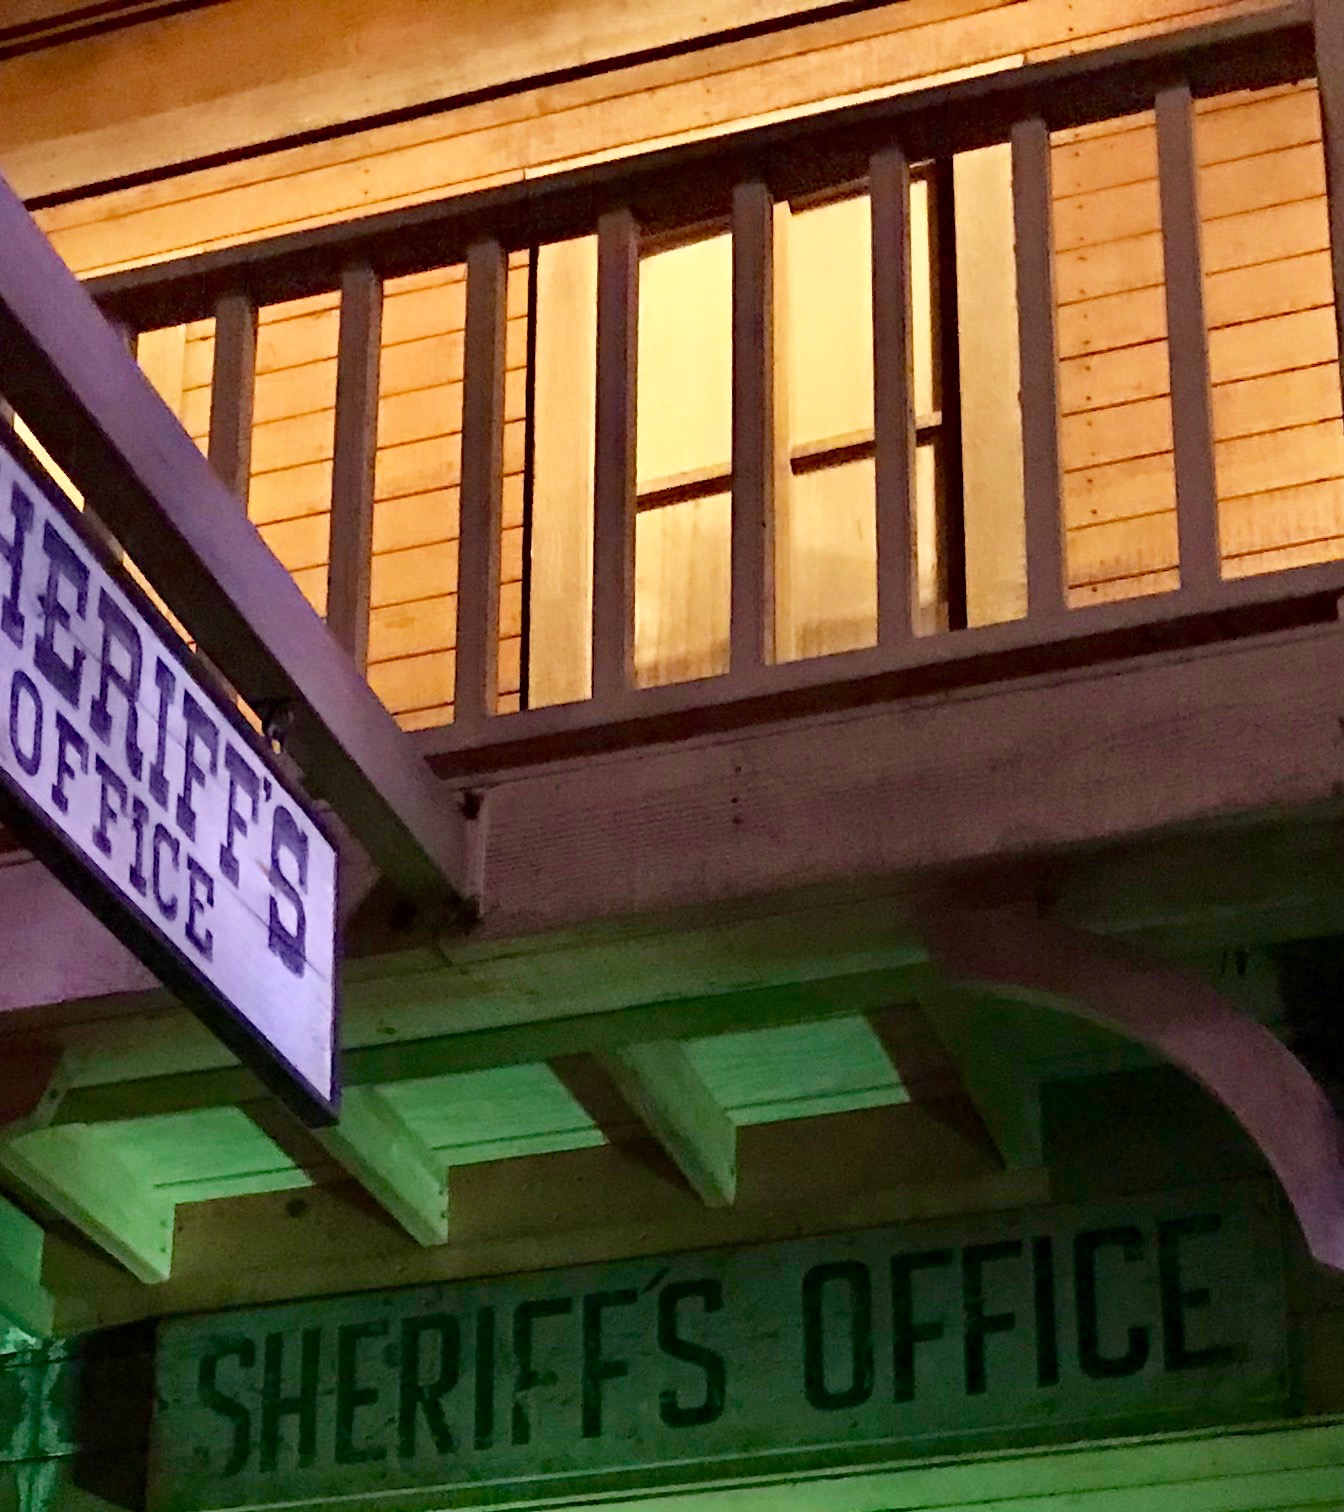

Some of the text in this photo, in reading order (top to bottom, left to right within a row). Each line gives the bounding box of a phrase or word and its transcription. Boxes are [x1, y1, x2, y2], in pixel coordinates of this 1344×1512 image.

[9, 669, 216, 964] OFFICE
[196, 1214, 1249, 1481] SHERIFF'S OFFICE
